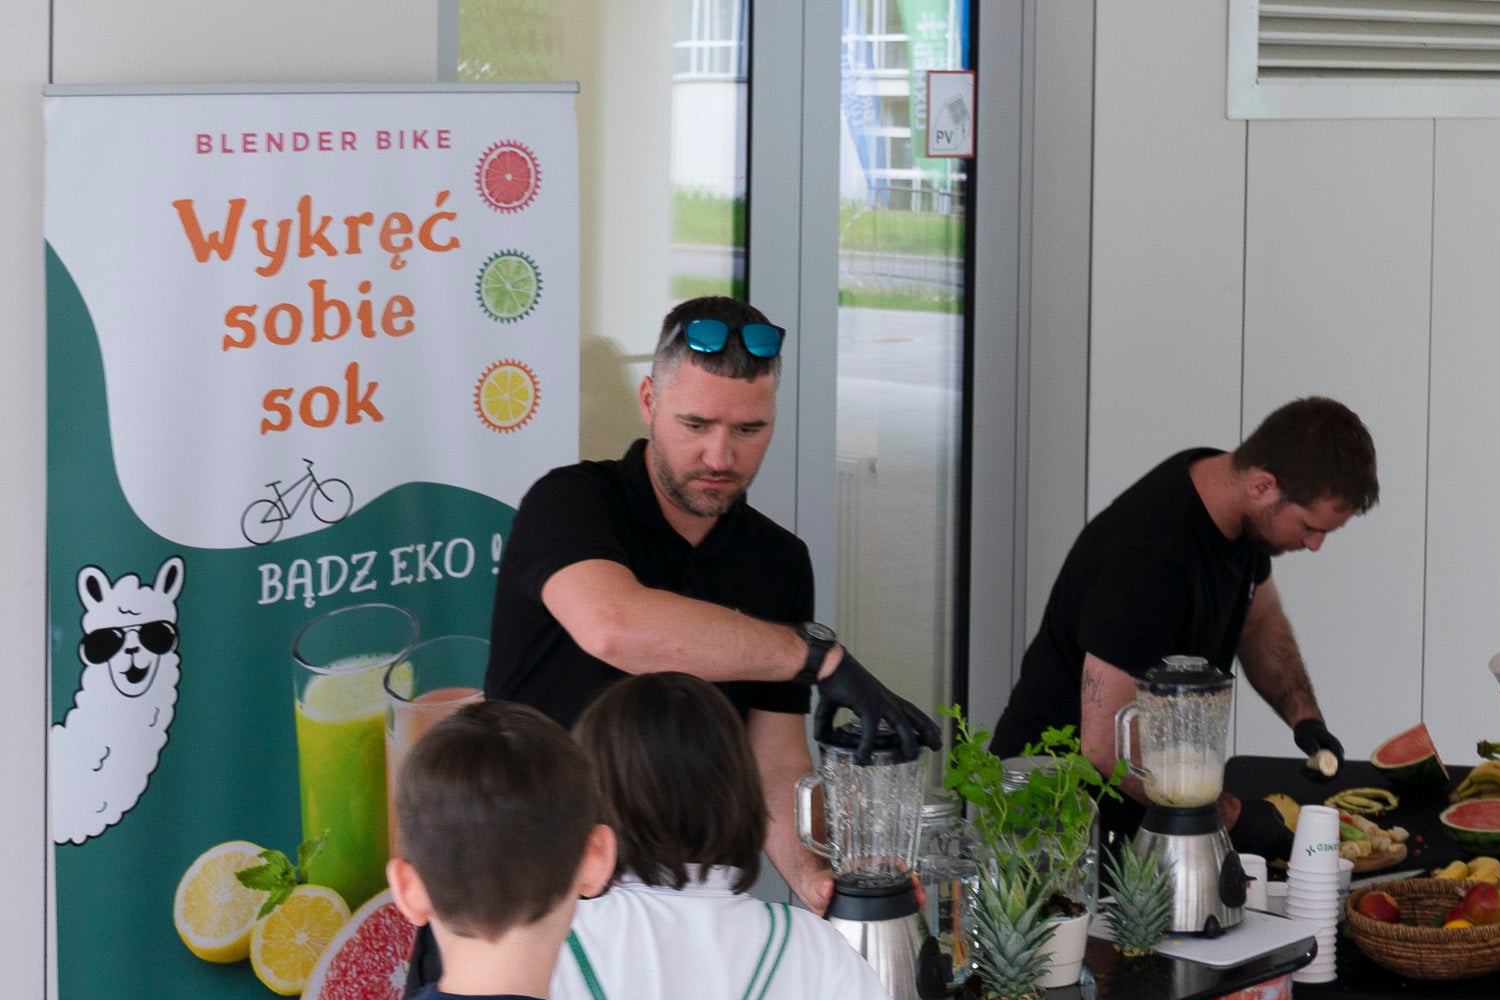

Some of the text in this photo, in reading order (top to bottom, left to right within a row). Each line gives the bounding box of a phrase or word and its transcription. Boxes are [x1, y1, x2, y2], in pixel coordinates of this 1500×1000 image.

[195, 129, 452, 154] BLENDER BIKE
[936, 130, 953, 144] PV
[173, 189, 460, 278] Wykręć
[222, 279, 415, 352] sobie
[260, 361, 384, 435] sok
[390, 538, 476, 587] EKO
